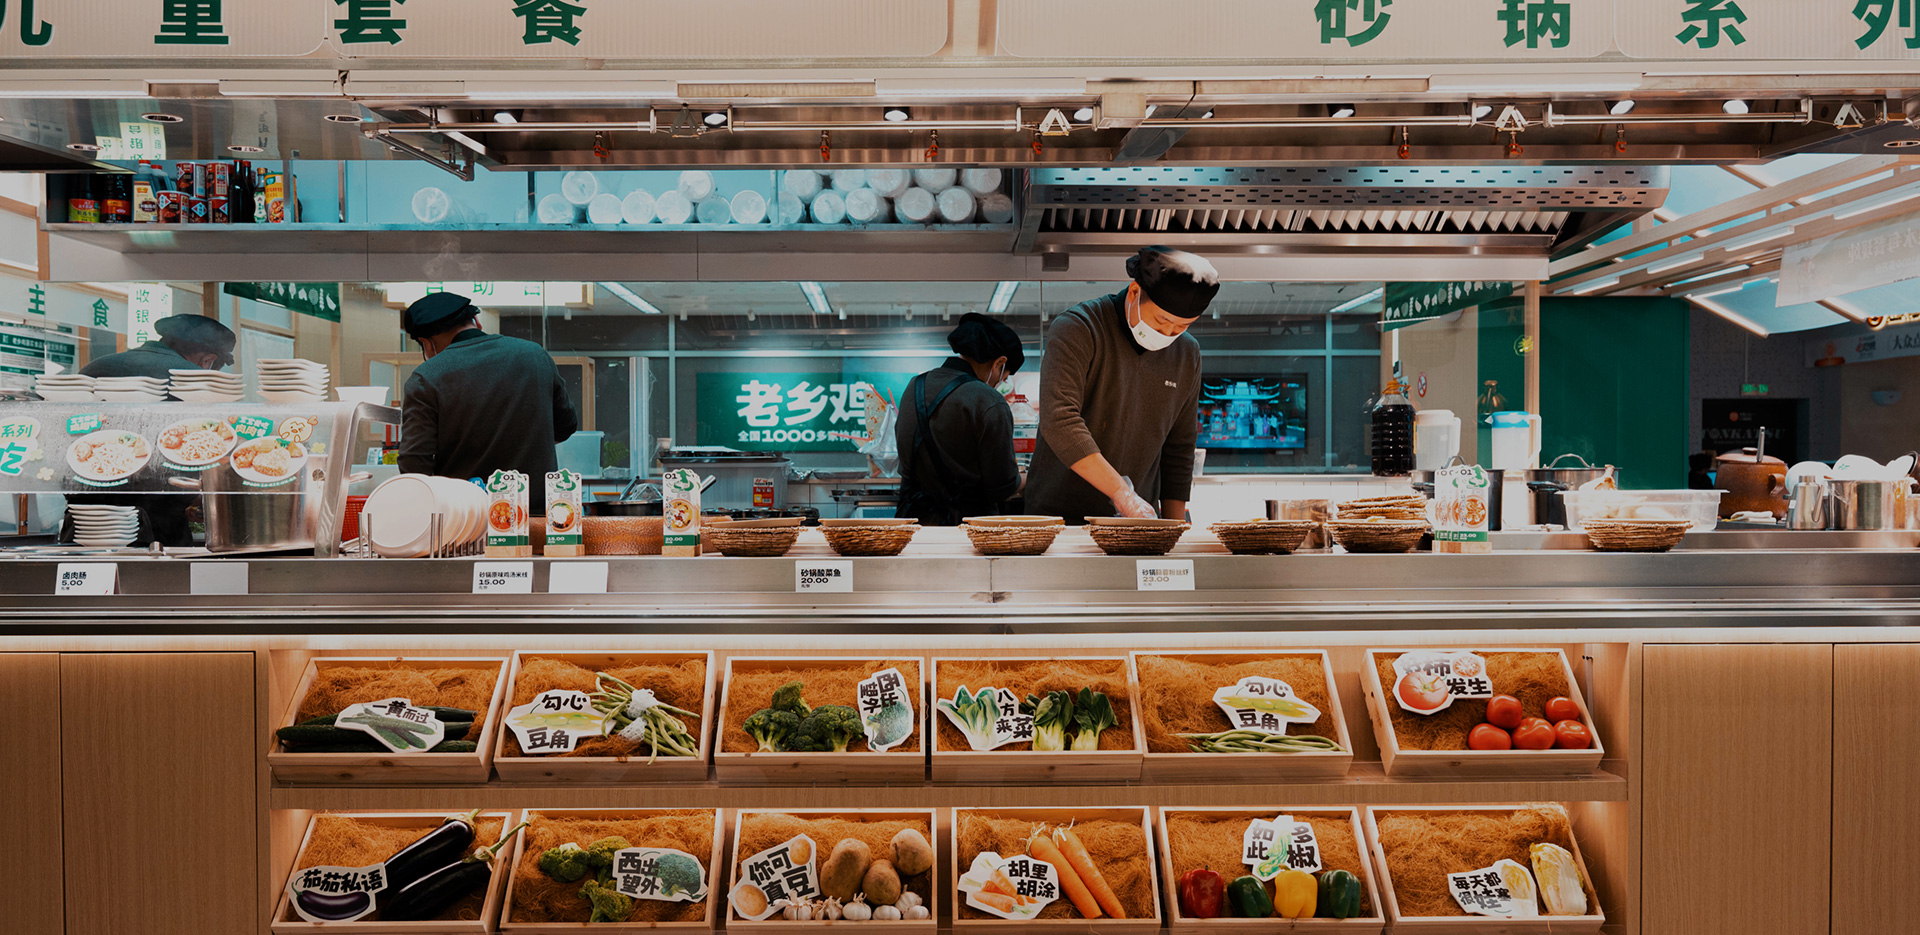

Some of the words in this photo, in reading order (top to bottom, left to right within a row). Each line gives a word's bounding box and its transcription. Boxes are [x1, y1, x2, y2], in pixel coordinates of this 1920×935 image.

[27, 284, 110, 329] 主食
[136, 288, 150, 344] 收银台
[736, 379, 874, 427] 老乡鸡
[62, 571, 87, 580] 卤肉肠
[800, 568, 841, 577] 砂锅酸菜鱼
[860, 681, 881, 713] 望外
[876, 672, 901, 707] 西出
[1245, 680, 1289, 699] 勾心
[1446, 677, 1492, 695] 发生
[372, 698, 430, 724] 一黄而过
[541, 692, 588, 711] 勾心
[1236, 708, 1280, 732] 豆角
[526, 727, 570, 750] 豆角
[618, 851, 660, 876] 西出
[748, 846, 792, 886] 你可
[1008, 860, 1048, 881] 胡里
[302, 867, 384, 894] 茄茄私语
[619, 873, 660, 895] 望外
[761, 865, 815, 907] 真豆
[1016, 879, 1056, 899] 胡涂
[1452, 871, 1502, 891] 每天都
